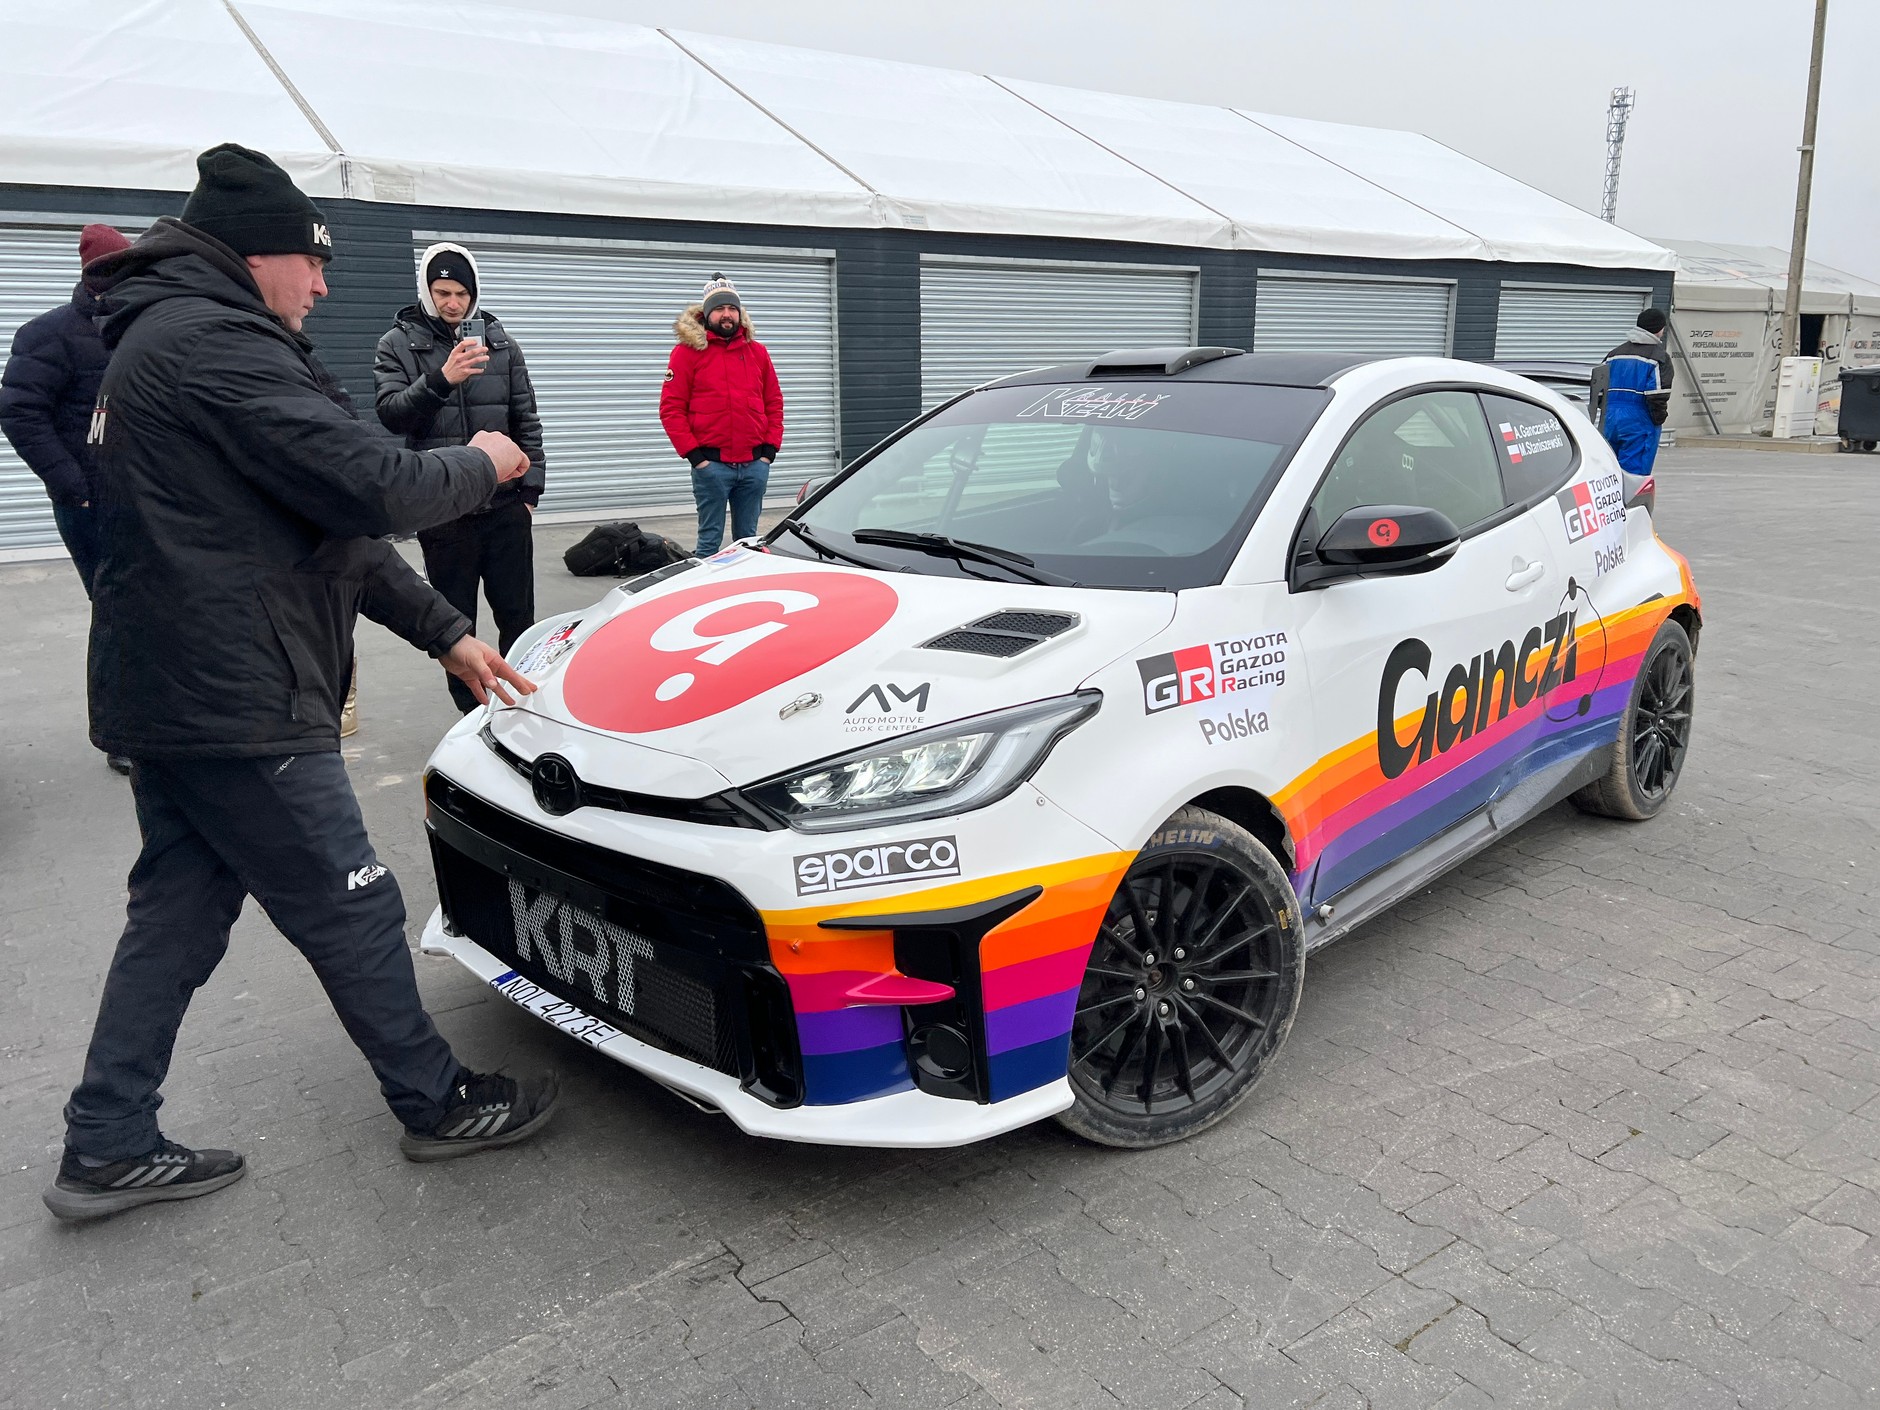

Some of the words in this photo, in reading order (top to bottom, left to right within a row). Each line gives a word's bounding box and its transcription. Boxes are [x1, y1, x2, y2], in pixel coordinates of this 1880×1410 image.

[1589, 473, 1619, 493] TOYOTA
[1595, 490, 1622, 510] GAZOO
[1599, 507, 1627, 527] Racing
[1594, 541, 1626, 577] Polska
[1214, 632, 1288, 656] TOYOTA
[1220, 650, 1286, 675] GAZOO
[1146, 665, 1213, 710] GR
[1221, 669, 1286, 694] Racing
[843, 716, 925, 725] AUTOMOTIVE
[1198, 708, 1270, 745] Polska
[798, 840, 956, 890] sparco
[508, 881, 655, 1015] KRT
[500, 977, 547, 1010] NOL
[540, 1001, 616, 1045] 4273E
